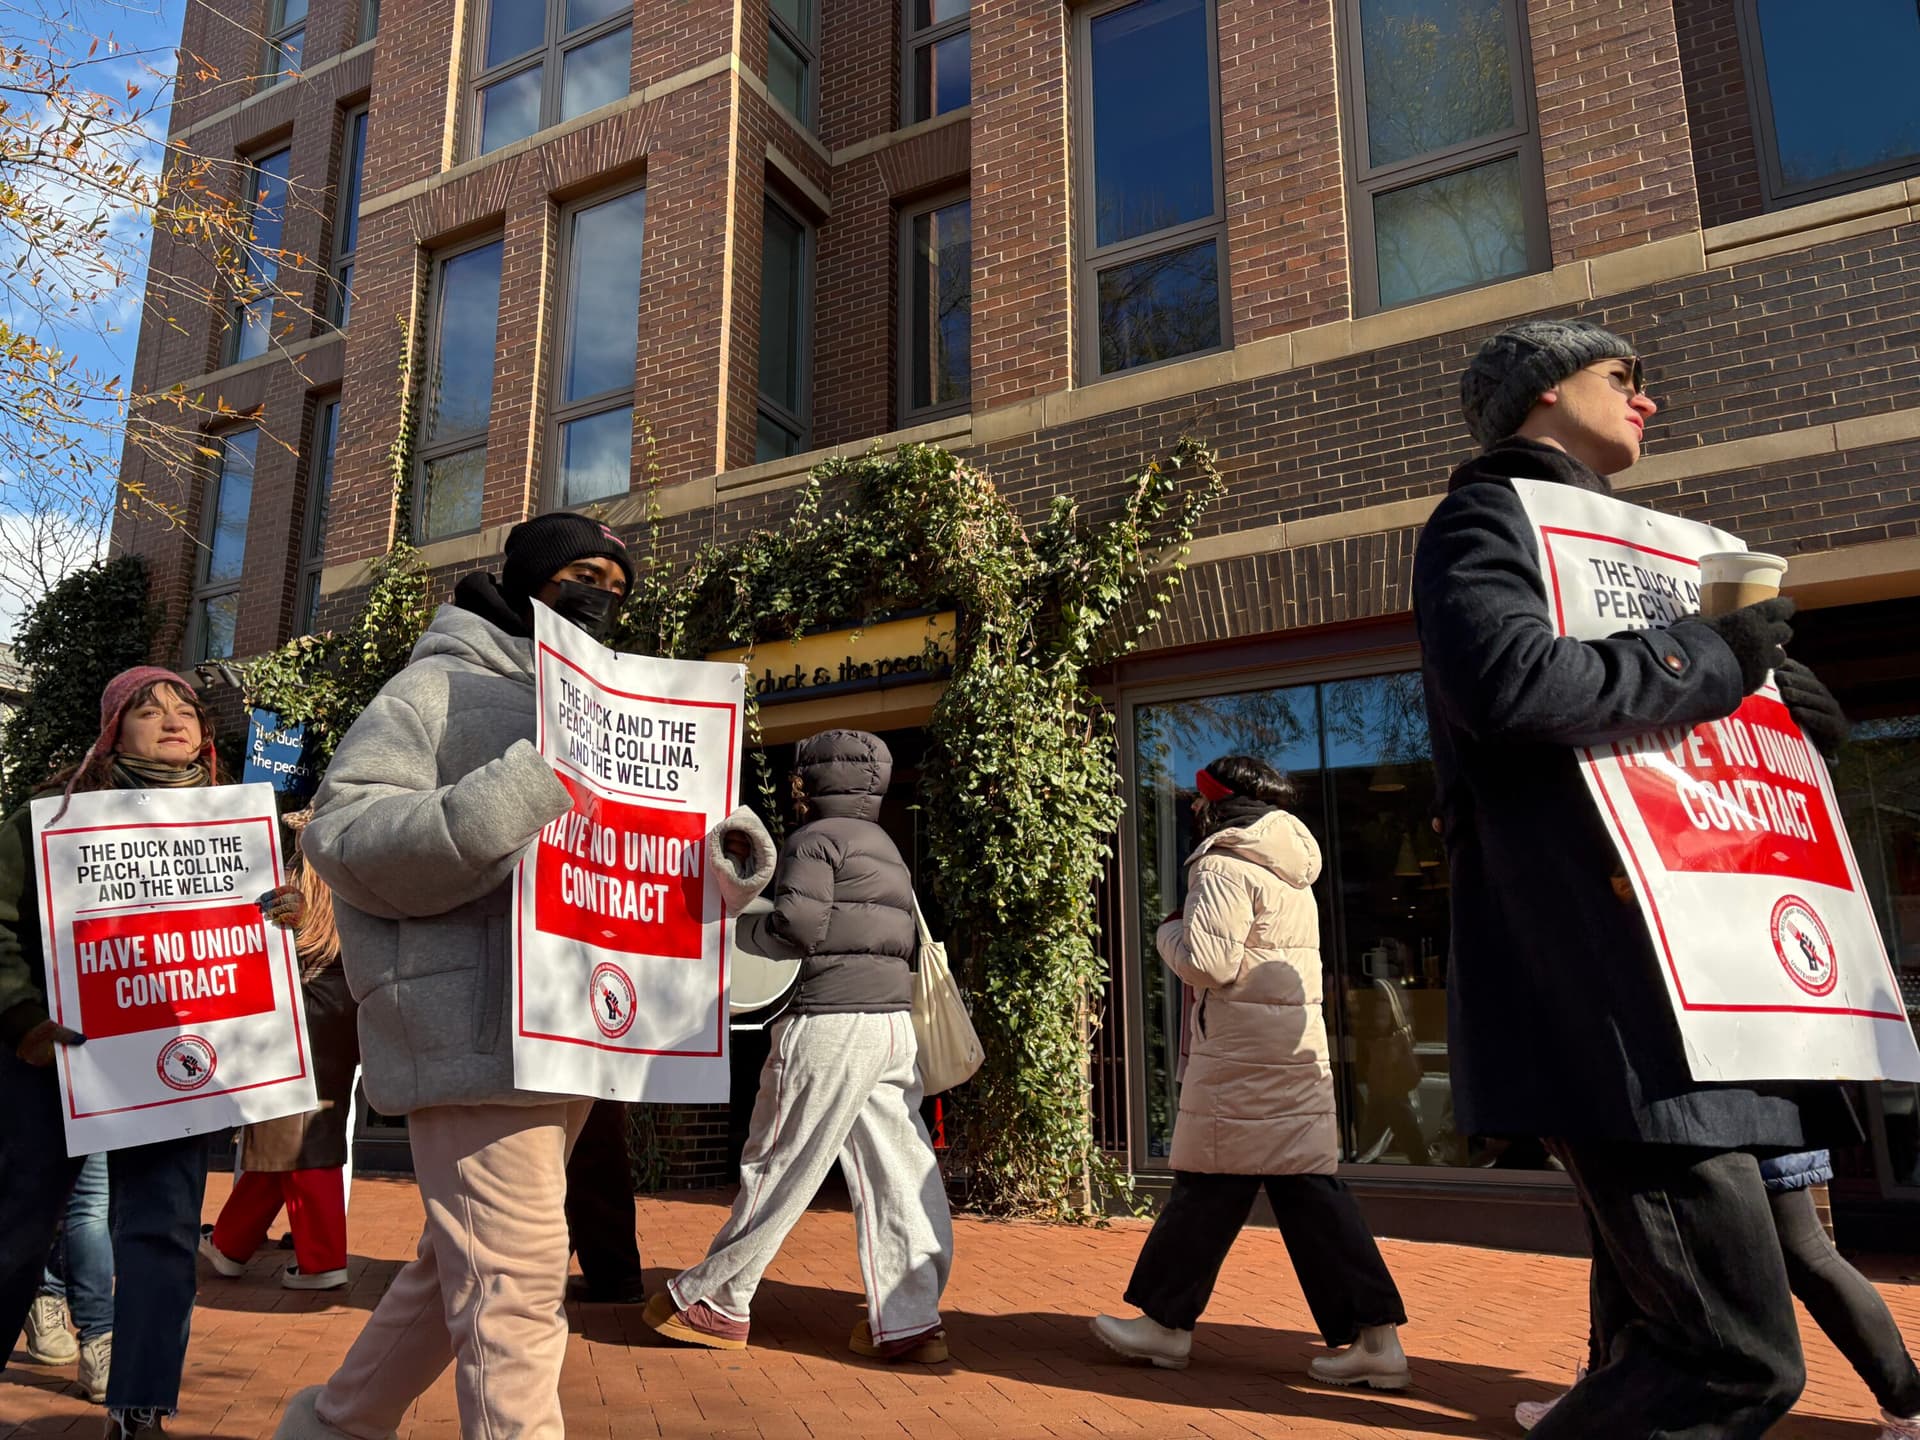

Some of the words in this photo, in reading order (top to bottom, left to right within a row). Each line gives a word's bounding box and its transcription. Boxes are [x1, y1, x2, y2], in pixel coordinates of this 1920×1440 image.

[1588, 558, 1636, 588] THE
[1633, 565, 1686, 602] DUCK
[756, 664, 807, 693] duck
[813, 667, 831, 685] &
[838, 656, 873, 682] the
[560, 678, 581, 712] THE
[583, 694, 613, 732] DUCK
[616, 713, 653, 738] AND
[658, 720, 696, 744] THE
[253, 740, 265, 752] &
[558, 704, 595, 748] PEACH,
[596, 732, 610, 753] LA
[614, 737, 700, 772] COLLINA,
[1617, 722, 1713, 768] HAVE
[1711, 716, 1759, 769] NO
[1751, 722, 1818, 788] UNION
[252, 752, 272, 769] the
[273, 761, 310, 777] peach
[569, 738, 590, 767] AND
[590, 750, 612, 780] THE
[616, 764, 679, 792] WELLS
[1675, 778, 1818, 844] CONTRACT
[79, 841, 116, 863] THE
[121, 840, 170, 859] DUCK
[172, 839, 206, 858] AND
[209, 836, 243, 854] THE
[542, 810, 589, 859] HAVE
[589, 820, 617, 867] NO
[624, 832, 700, 878] UNION
[77, 861, 146, 884] PEACH,
[150, 859, 171, 878] LA
[173, 855, 250, 876] COLLINA,
[99, 882, 136, 903] AND
[140, 878, 174, 898] THE
[176, 875, 234, 895] WELLS
[561, 862, 669, 924] CONTRACT
[79, 935, 148, 974] HAVE
[154, 931, 187, 964] NO
[191, 924, 265, 960] UNION
[115, 963, 238, 1009] CONTRACT
